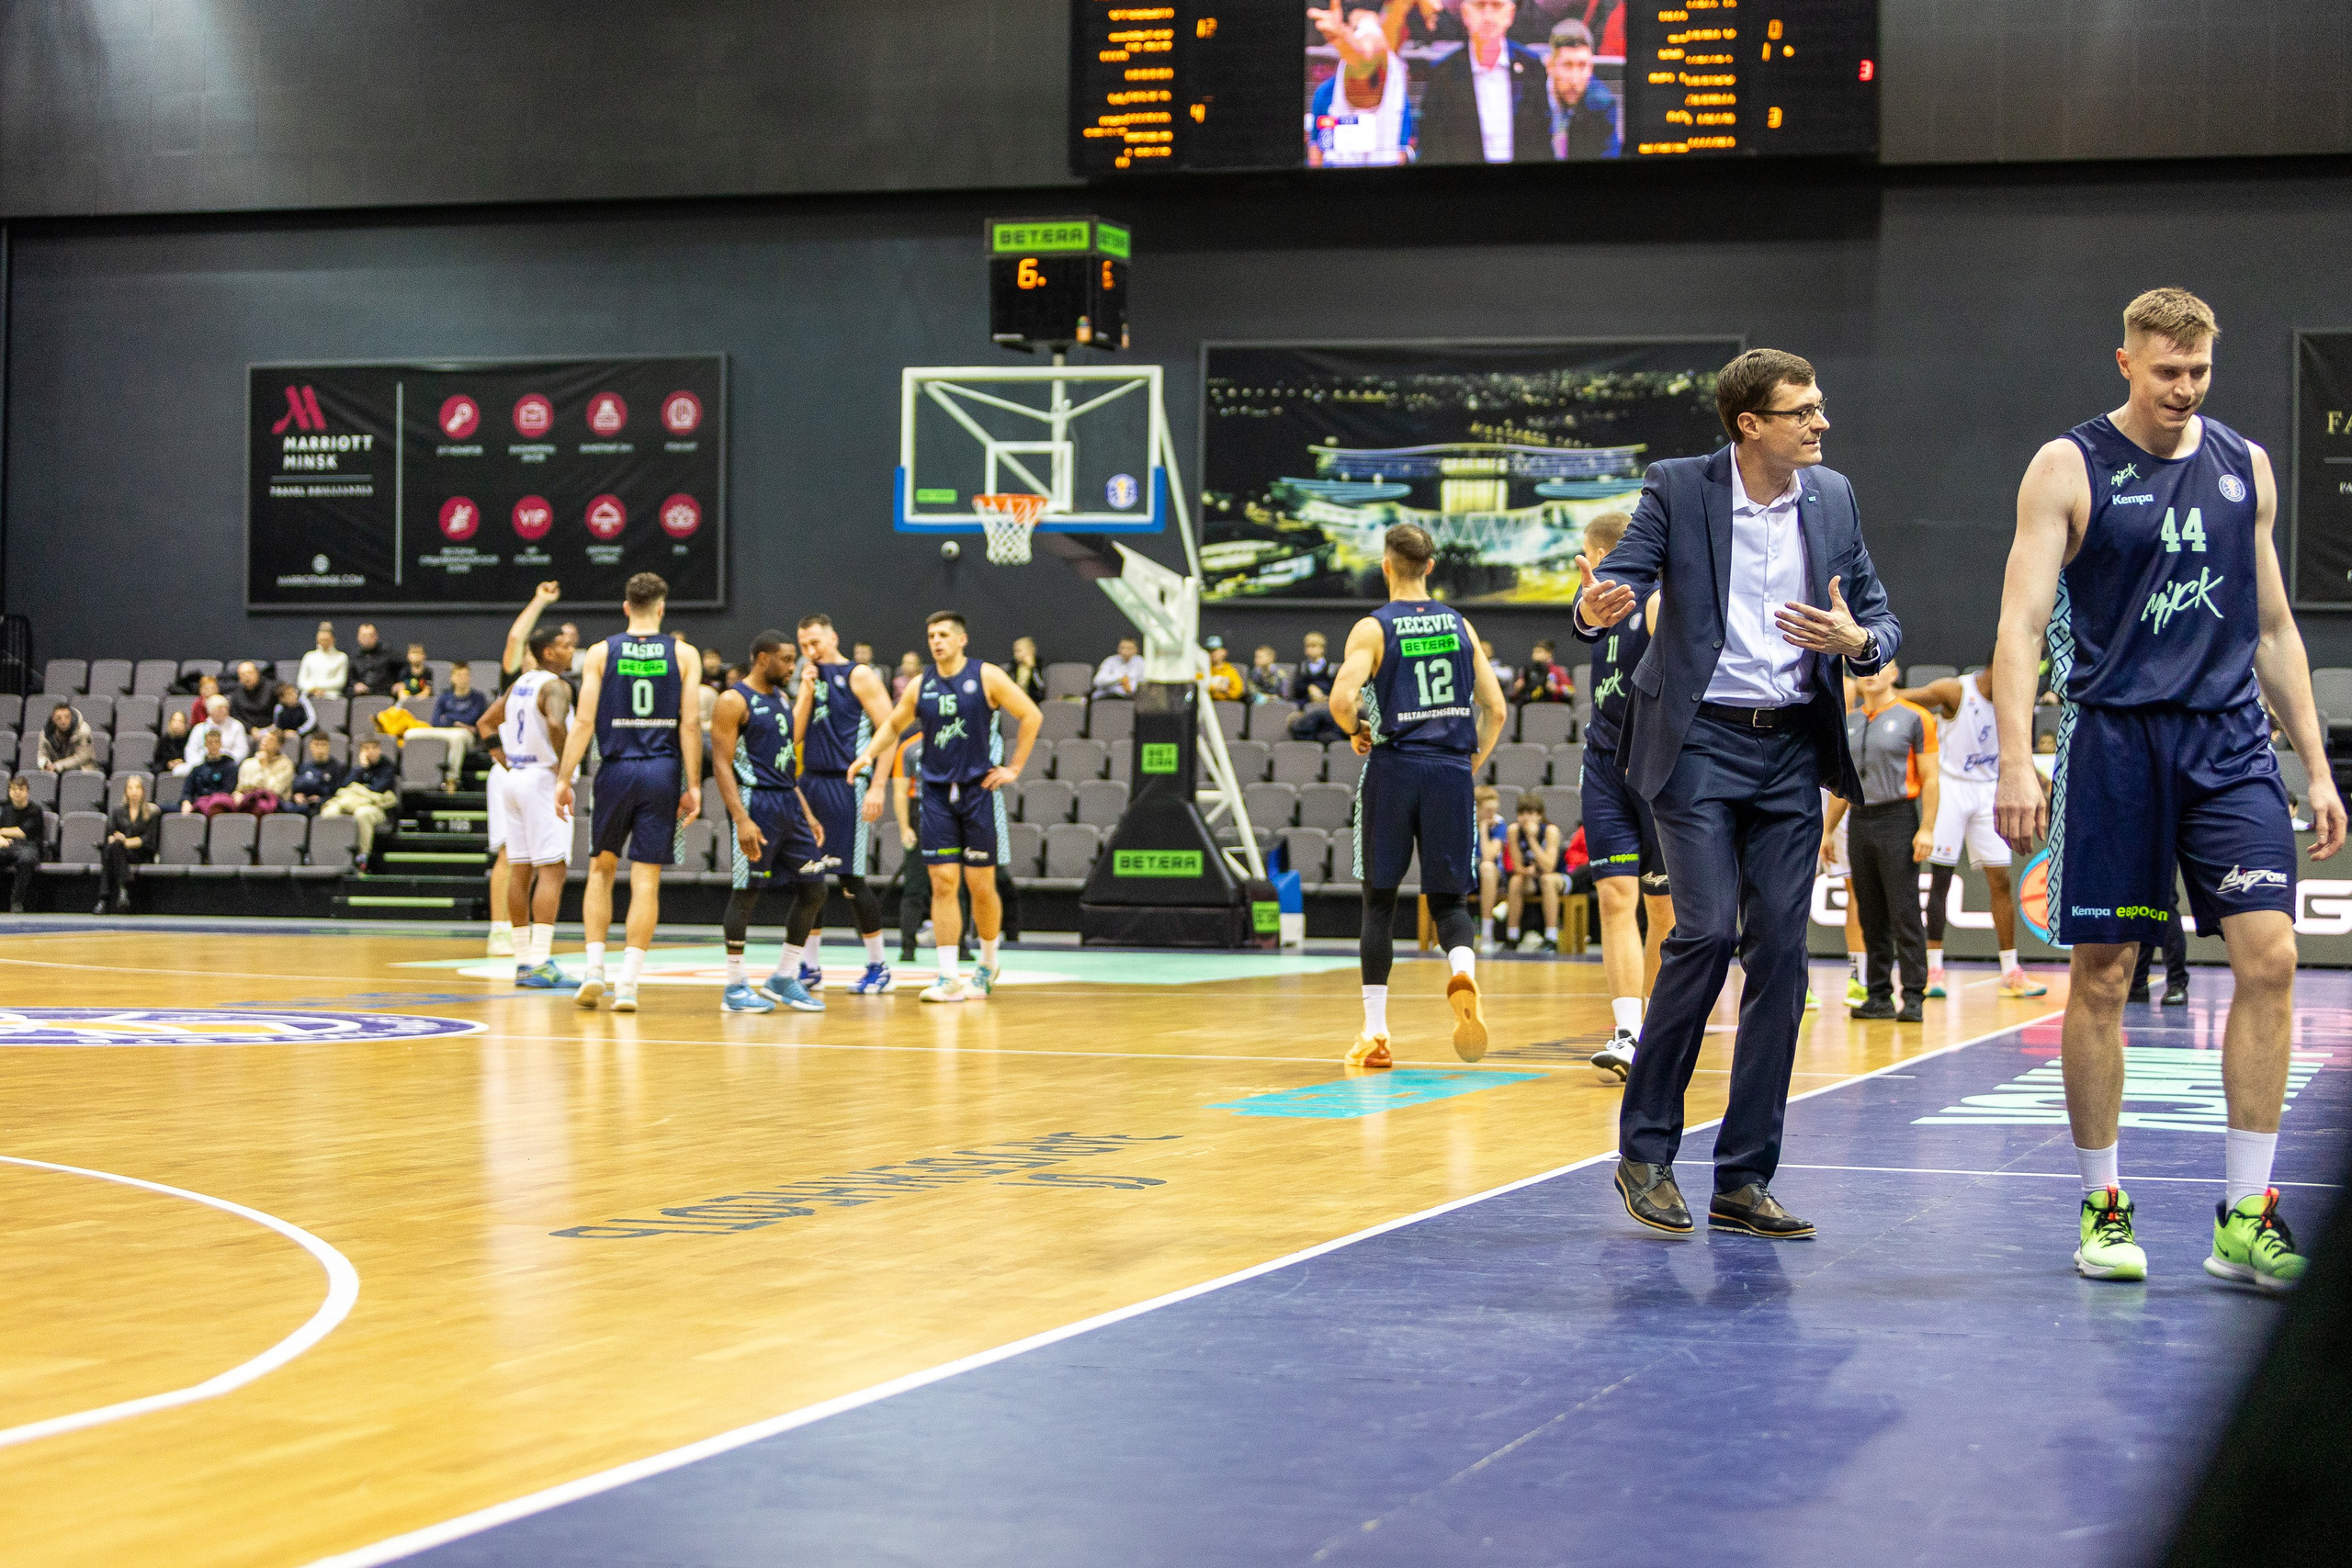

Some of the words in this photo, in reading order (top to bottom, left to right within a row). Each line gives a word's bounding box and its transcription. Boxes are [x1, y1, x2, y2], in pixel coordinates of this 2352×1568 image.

[1000, 230, 1082, 245] BETERA
[283, 435, 374, 452] MARRIOTT
[283, 454, 338, 470] MINSK
[2112, 493, 2154, 505] Kempa
[518, 509, 548, 527] VIP
[2161, 507, 2208, 553] 44
[1393, 613, 1458, 636] ZECEVIC
[1405, 637, 1455, 652] BETERA
[1606, 635, 1620, 662] 11
[1414, 659, 1455, 707] 12
[632, 679, 654, 717] 0
[938, 694, 958, 716] 15
[1397, 706, 1471, 723] BELTAMOZHSERVICE
[775, 713, 788, 736] 3
[1120, 855, 1196, 869] BETERA
[2072, 906, 2111, 919] Kempa
